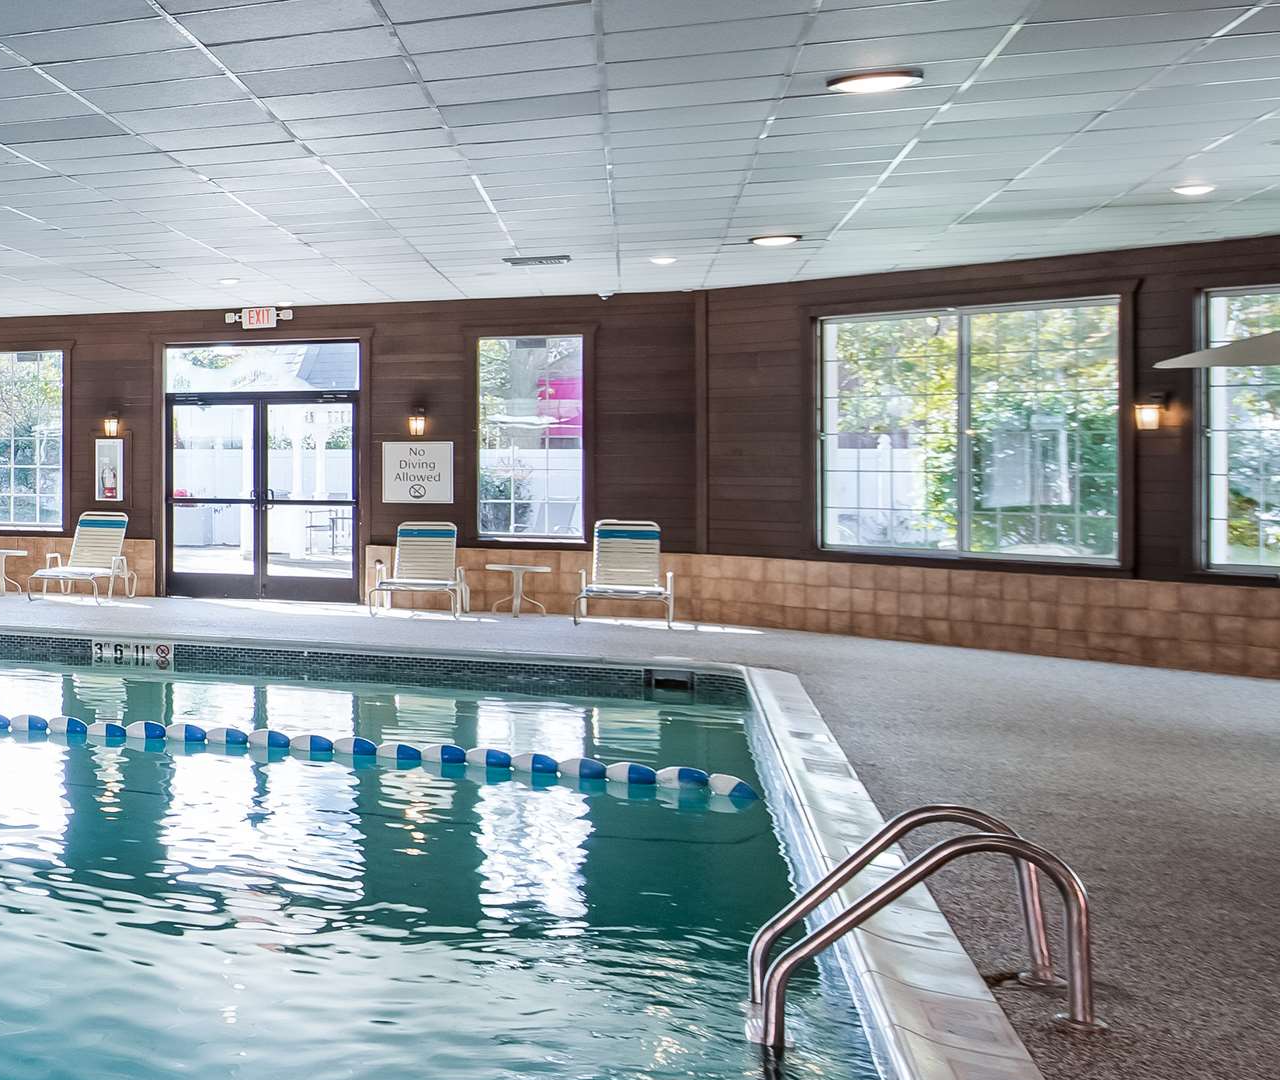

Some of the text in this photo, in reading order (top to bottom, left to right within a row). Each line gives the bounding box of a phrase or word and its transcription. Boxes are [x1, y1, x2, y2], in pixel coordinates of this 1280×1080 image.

[248, 309, 270, 324] EXIT
[409, 448, 425, 456] No
[399, 460, 436, 471] Diving
[394, 472, 441, 482] Allowed
[94, 643, 103, 653] 3
[114, 644, 123, 656] 6
